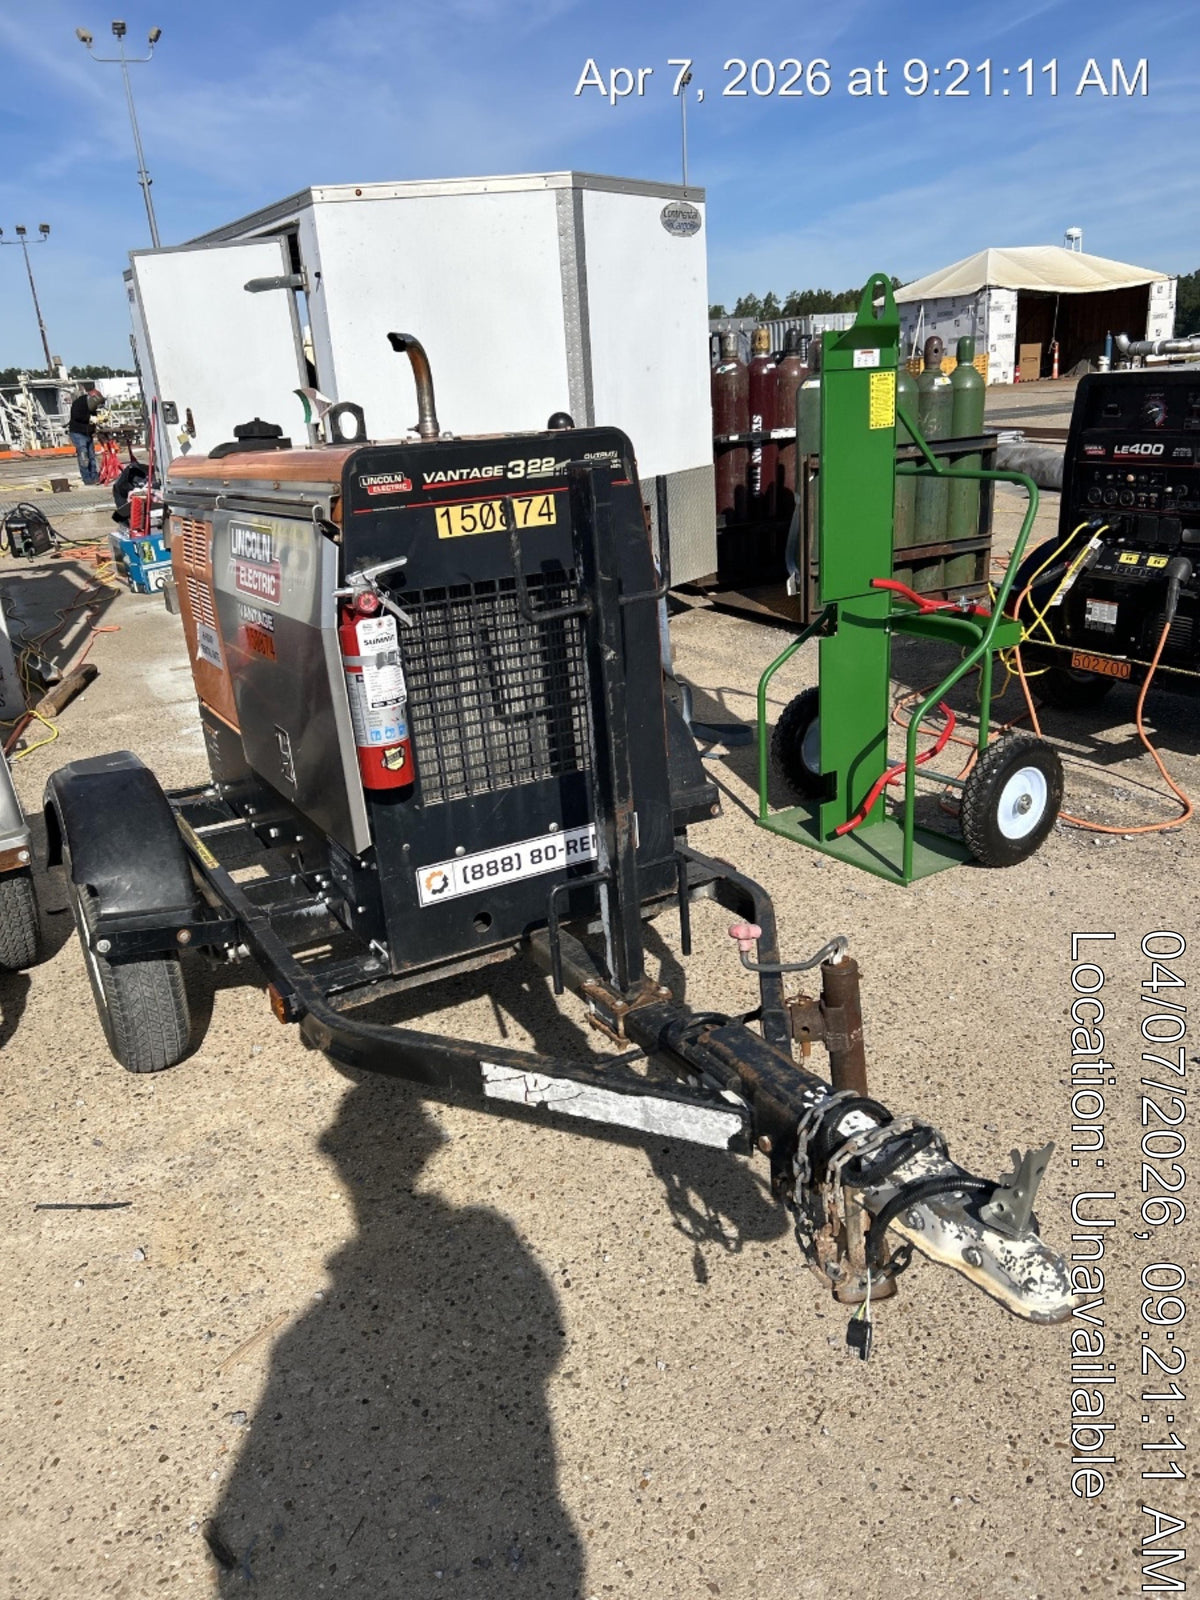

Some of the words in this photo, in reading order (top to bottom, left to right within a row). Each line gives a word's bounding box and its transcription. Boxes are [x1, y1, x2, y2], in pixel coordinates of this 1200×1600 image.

[1113, 443, 1165, 455] LE400
[361, 474, 403, 486] LINCOLN
[422, 465, 505, 484] VANTAGE
[507, 457, 556, 479] 322
[372, 483, 409, 493] ELECTRIC
[231, 527, 272, 563] LINCOLN
[239, 565, 276, 596] ELECTRIC
[1072, 654, 1130, 678] 502700
[462, 852, 523, 884] (888)
